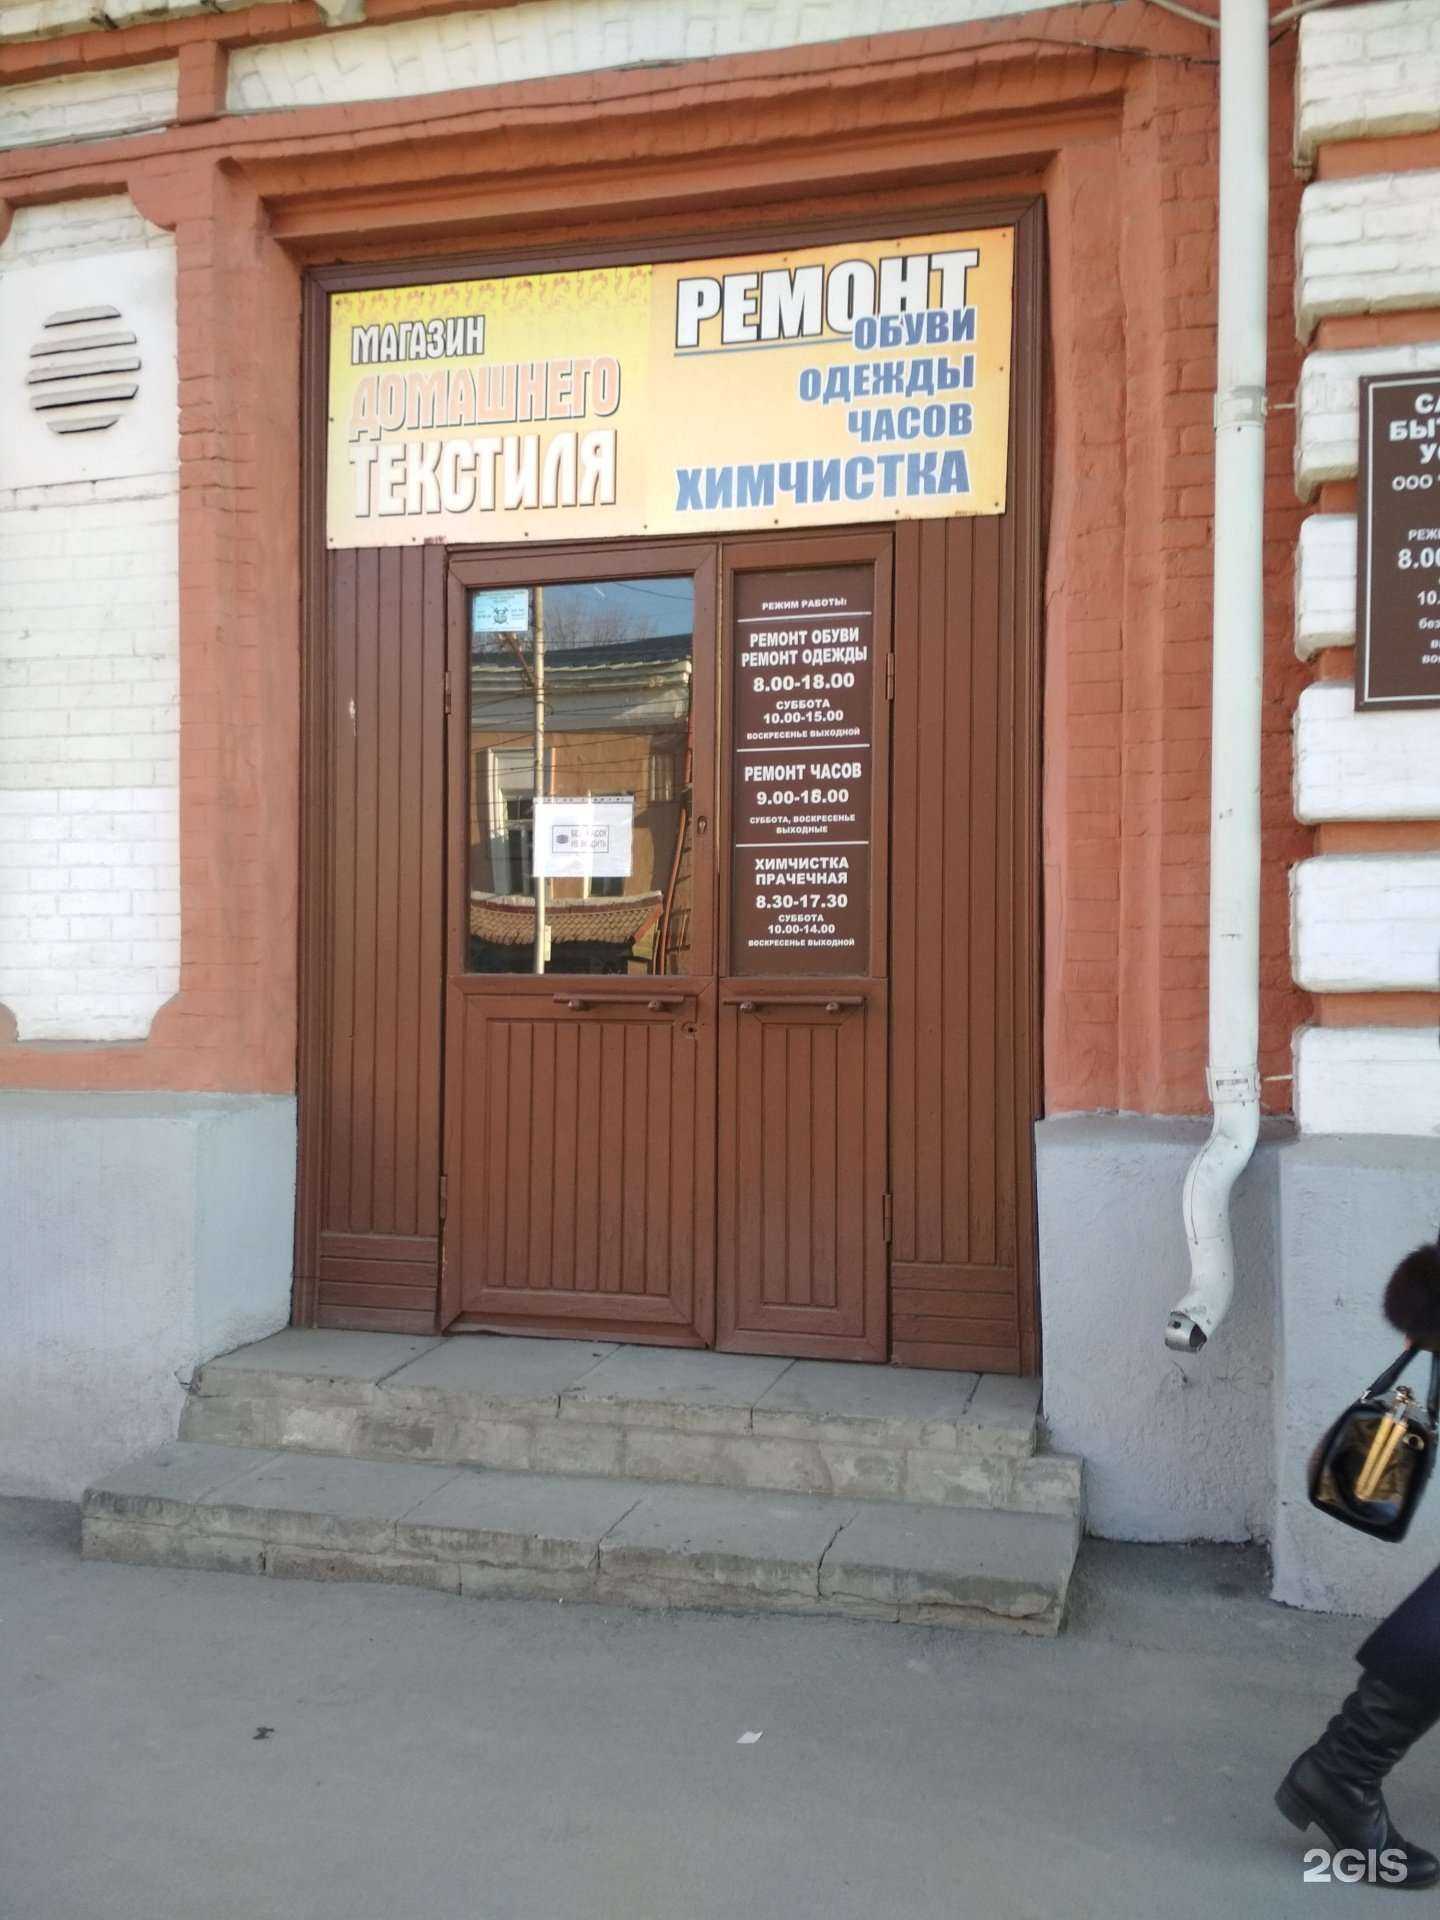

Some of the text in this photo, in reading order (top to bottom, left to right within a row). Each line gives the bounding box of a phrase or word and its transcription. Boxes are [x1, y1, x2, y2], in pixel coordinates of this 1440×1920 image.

[675, 249, 980, 348] РЕМОНТ
[854, 308, 976, 350] ОБУВИ
[351, 315, 485, 365] МАГАЗИН
[799, 355, 974, 404] ОДЕЖДЫ
[348, 356, 621, 442] ДОМАШНЕГО
[848, 403, 973, 442] ЧАСОВ
[1389, 418, 1440, 441] БЫ
[349, 429, 617, 517] ТЕКСТИЛЯ
[675, 450, 970, 511] ХИМЧИСТКА
[762, 600, 799, 611] РЕЖИМ
[750, 627, 859, 647] РЕМОНТ ОБУВИ
[741, 646, 868, 667] РЕМОНТ ОДЕЖДЫ
[753, 672, 855, 692] 8.00-18.00
[776, 699, 830, 710] СУББОТА
[763, 710, 844, 724] 10.00-15.00
[747, 727, 860, 740] ВОСКРЕСЕНЬЕ ВЫХОДНОЙ
[745, 762, 862, 782] РЕМОНТ ЧАСОВ
[793, 814, 856, 823] ВОСКРЕСЕНЬЕ
[776, 825, 828, 834] ВЫХОДНЫЕ
[755, 856, 849, 870] ХИМЧИСТКА
[756, 872, 848, 885] ПРАЧЕЧНАЯ
[756, 893, 848, 909] 8.30-17.30
[778, 914, 824, 922] СУББОТА
[768, 924, 835, 934] 10.00-14.00
[748, 938, 855, 947] ВОСКРЕСЕНЬЕ ВЫХОДНОЙ
